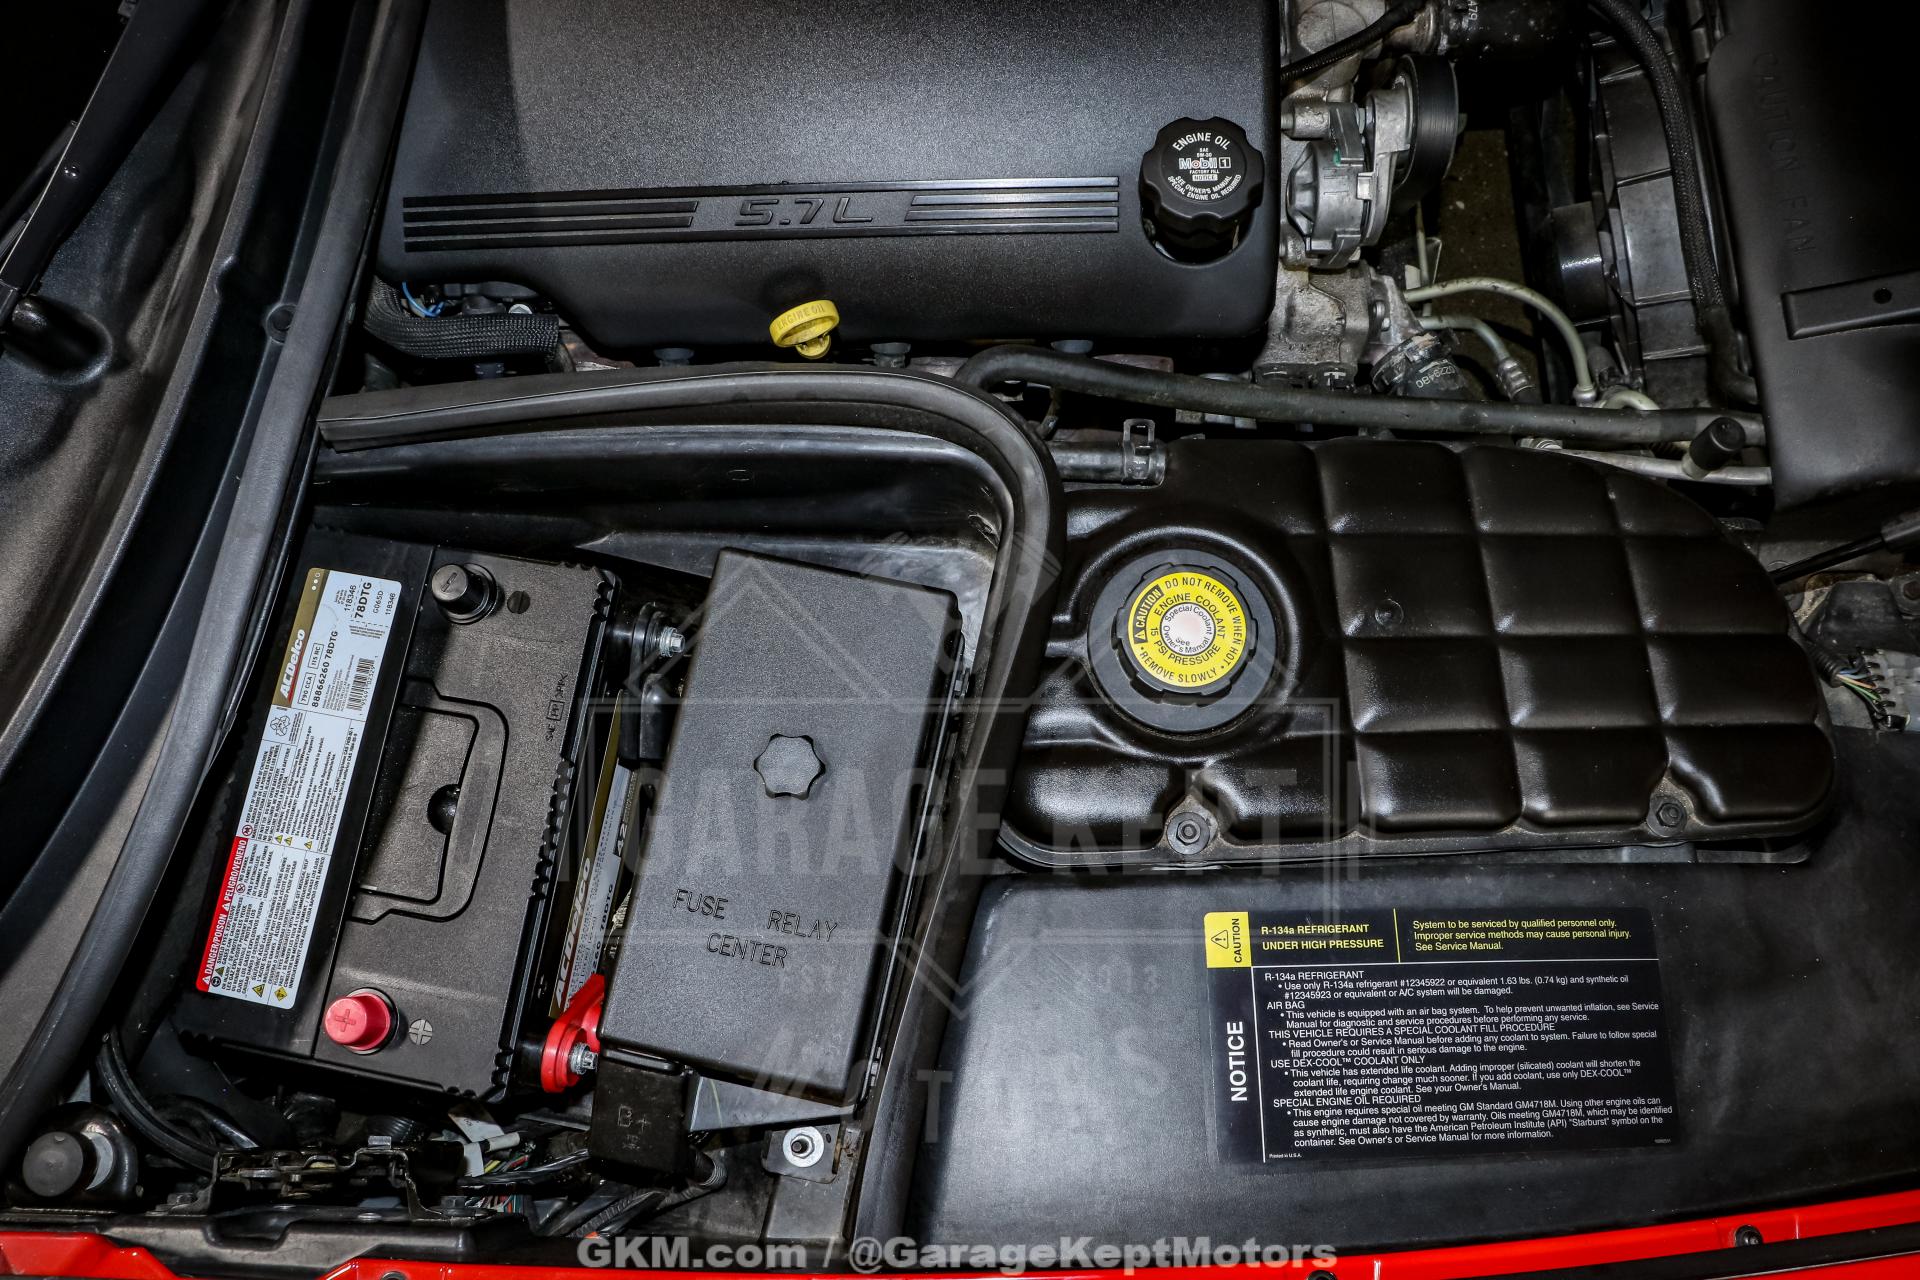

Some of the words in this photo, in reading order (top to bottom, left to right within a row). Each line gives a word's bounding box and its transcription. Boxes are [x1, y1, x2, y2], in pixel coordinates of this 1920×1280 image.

[1172, 132, 1212, 151] ENGINE
[1214, 135, 1230, 150] OIL
[1179, 158, 1217, 169] Mobil
[1168, 176, 1185, 194] SPECIAL
[1221, 174, 1241, 196] REQUIRED
[1175, 175, 1186, 185] SEE
[1185, 184, 1211, 194] OWNER'S
[1212, 175, 1233, 192] MANUAL
[734, 197, 873, 226] 5.7L
[777, 307, 810, 329] ENGINE
[811, 304, 825, 313] OIL
[1165, 577, 1178, 589] DO
[1182, 577, 1202, 586] NOT
[354, 582, 372, 619] 78DTG
[1136, 588, 1162, 627] CAUTION
[1204, 581, 1238, 614] REMOVE
[1154, 593, 1191, 616] ENGINE
[1195, 595, 1225, 639] COOLANT
[1165, 605, 1192, 622] Special
[1193, 606, 1213, 635] Coolant
[1163, 625, 1183, 653] Owner's
[1185, 637, 1210, 653] Manual
[1232, 615, 1243, 645] WHEN
[1150, 627, 1158, 636] 15
[1154, 640, 1168, 656] PSI
[1168, 645, 1220, 666] PRESSURE
[1175, 638, 1190, 646] See
[280, 629, 306, 699] ACDelco
[1140, 651, 1175, 681] REMOVE
[1178, 667, 1218, 683] SLOWLY
[1225, 647, 1238, 666] HOT
[311, 662, 330, 707] 88866260
[325, 630, 338, 660] 78DTG
[305, 676, 313, 688] CCA
[224, 840, 247, 902] PELIGRO/VENENO
[672, 888, 728, 919] FUSE
[767, 909, 838, 942] RELAY
[1413, 921, 1445, 930] System
[1509, 920, 1518, 930] by
[1521, 920, 1555, 930] qualified
[1558, 920, 1597, 929] personnel
[1599, 919, 1616, 929] only.
[556, 858, 590, 1008] ACDelco
[1262, 925, 1294, 934] R-134a
[1298, 924, 1369, 934] REFRIGERANT
[1414, 932, 1453, 941] Improper
[1572, 930, 1606, 940] personal
[1609, 930, 1631, 939] injury.
[204, 914, 227, 975] DANGER/POISON
[706, 933, 788, 968] CENTER
[1233, 918, 1243, 964] CAUTION
[1263, 941, 1298, 950] UNDER
[1302, 940, 1326, 949] HIGH
[1329, 939, 1384, 949] PRESSURE
[1436, 942, 1467, 950] Service
[1470, 942, 1503, 950] Manual.
[1298, 971, 1364, 980] REFRIGERANT
[1304, 982, 1320, 991] only
[1356, 980, 1398, 990] refrigerant
[1401, 978, 1445, 987] #12345922
[1458, 978, 1498, 988] equivalent
[1535, 977, 1554, 986] (0.74
[1556, 977, 1568, 986] kg)
[1586, 976, 1618, 985] synthetic
[1285, 991, 1331, 999] #12345923
[1345, 990, 1386, 1000] equivalent
[1417, 988, 1445, 998] system
[1474, 987, 1512, 997] damaged.
[1293, 1029, 1333, 1037] VEHICLE
[1336, 1028, 1384, 1036] REQUIRES
[1394, 1026, 1433, 1035] SPECIAL
[1435, 1025, 1478, 1034] COOLANT
[1500, 1023, 1555, 1032] PROCEDURE
[1226, 1021, 1247, 1101] NOTICE
[1271, 1060, 1290, 1068] USE
[1354, 1057, 1398, 1065] COOLANT
[1274, 1099, 1314, 1107] SPECIAL
[1316, 1097, 1352, 1106] ENGINE
[1355, 1097, 1370, 1105] OIL
[1372, 1095, 1421, 1104] REQUIRED
